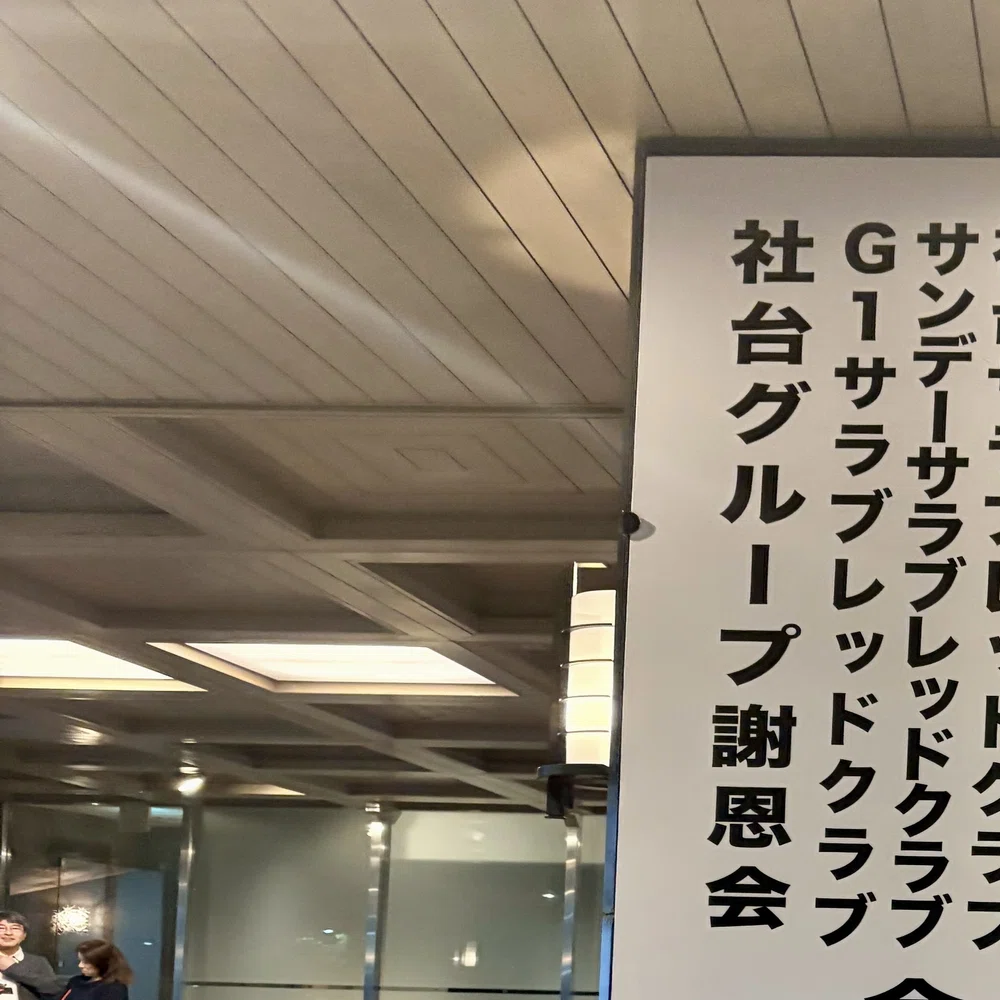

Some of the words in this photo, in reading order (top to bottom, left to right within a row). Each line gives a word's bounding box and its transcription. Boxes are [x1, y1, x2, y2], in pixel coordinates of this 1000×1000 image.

[705, 219, 815, 931] 社台グループ謝恩会
[814, 221, 897, 947] G1サラブレッドクラブ
[890, 221, 981, 949] サンデーサラブレッドクラブ
